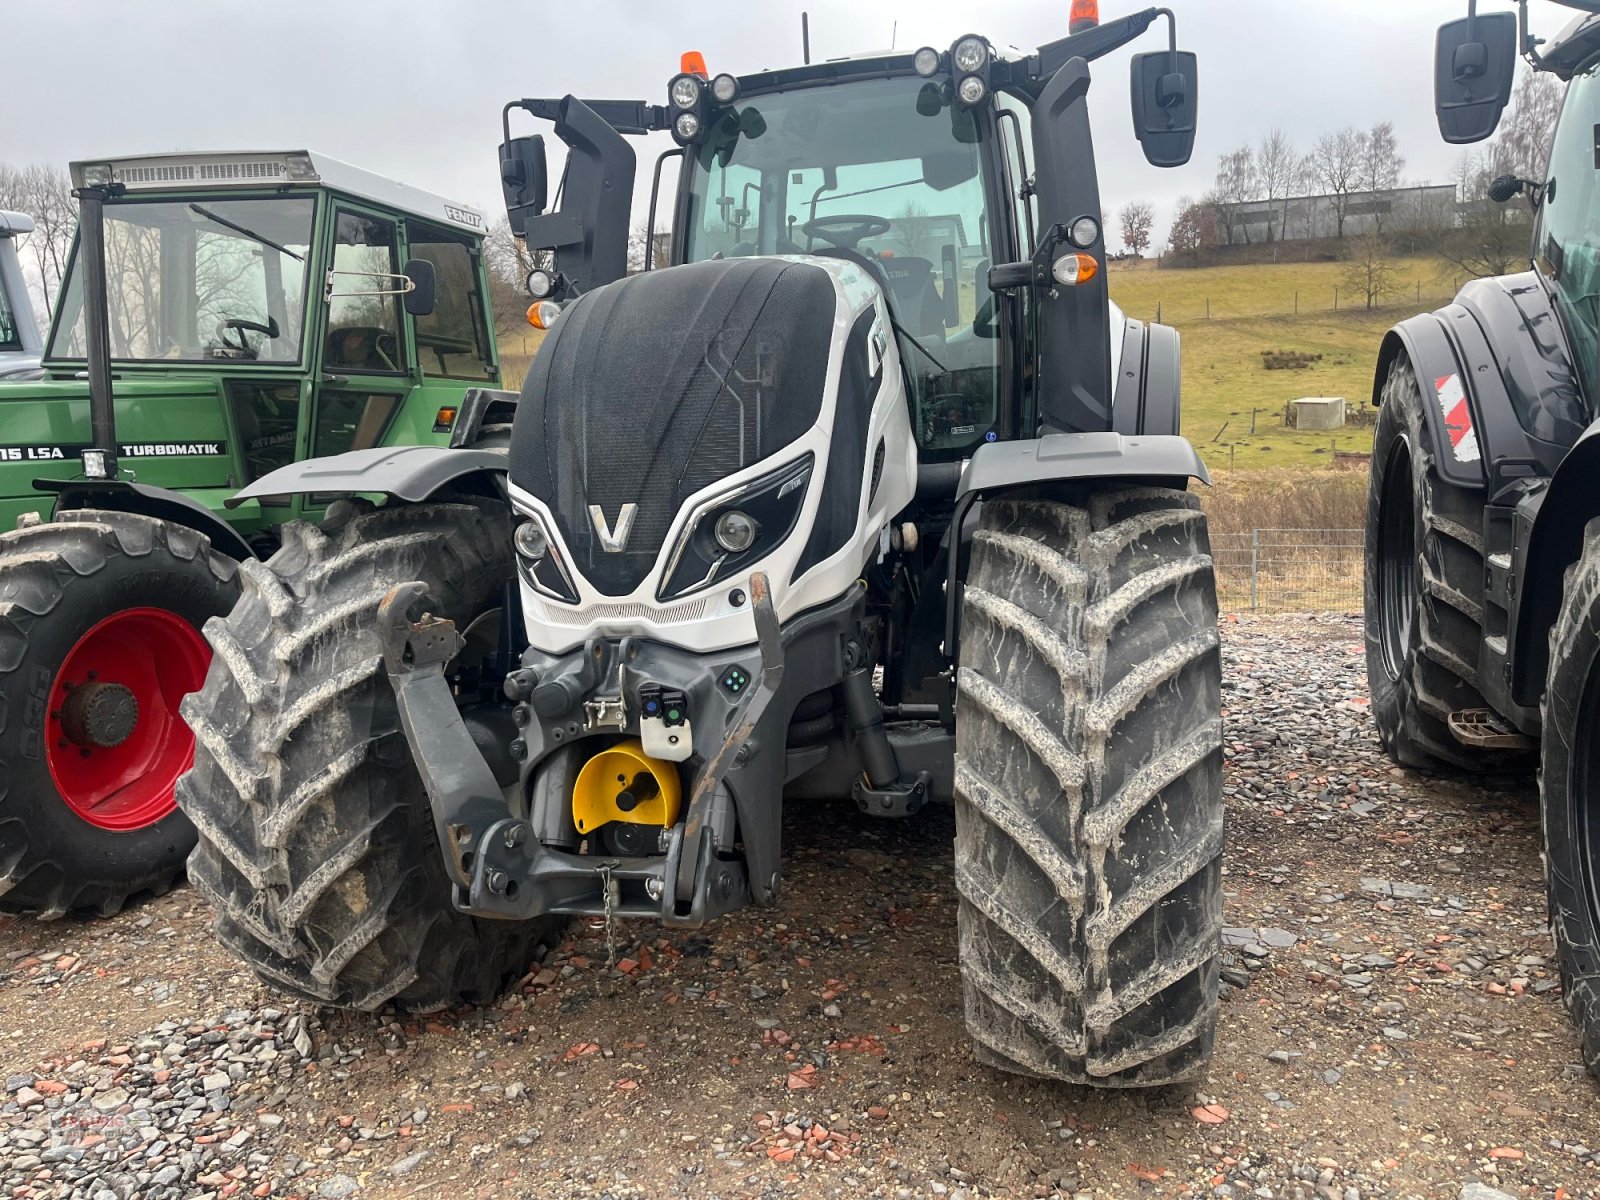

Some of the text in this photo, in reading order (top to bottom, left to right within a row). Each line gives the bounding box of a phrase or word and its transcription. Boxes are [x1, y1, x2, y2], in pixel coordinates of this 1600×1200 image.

[445, 205, 481, 228] FENDT
[27, 446, 65, 459] LSA
[121, 443, 219, 456] TURBOMATIK
